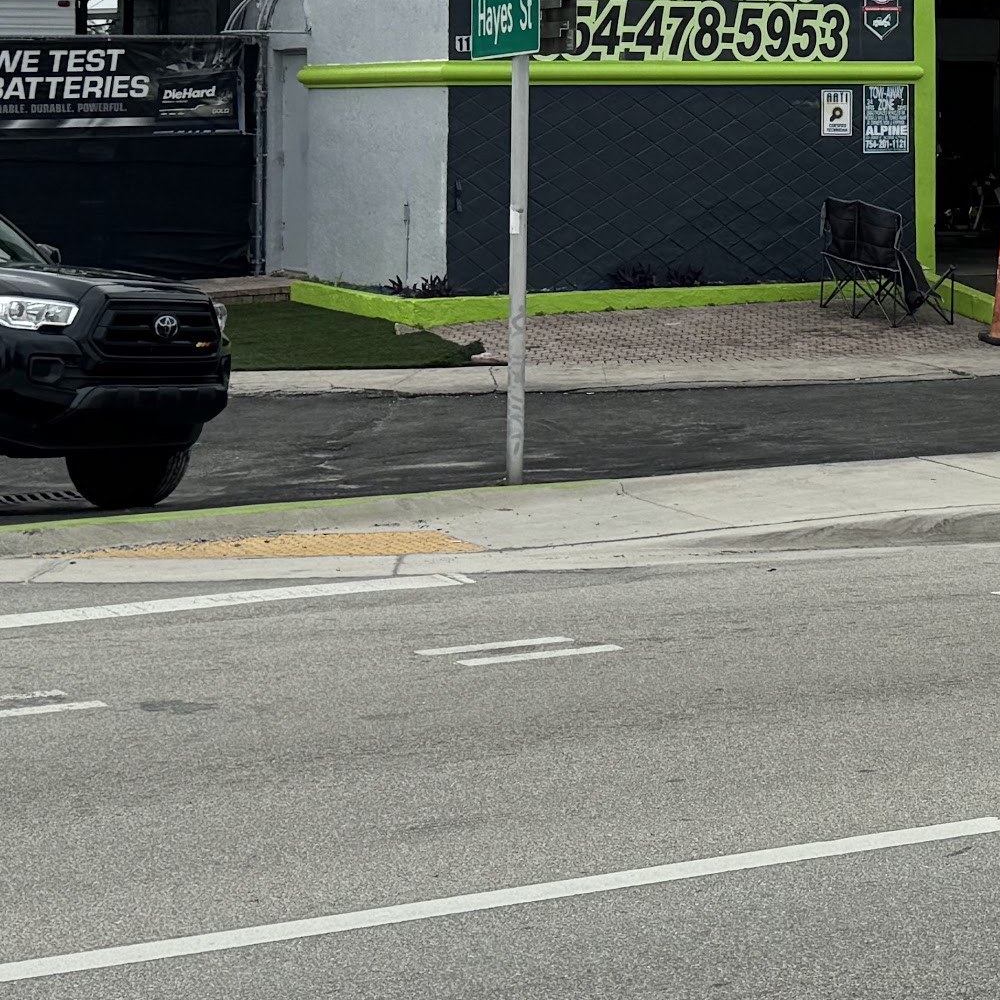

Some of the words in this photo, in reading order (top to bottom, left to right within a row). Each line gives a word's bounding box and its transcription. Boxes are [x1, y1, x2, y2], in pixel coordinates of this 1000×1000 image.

[477, 0, 513, 45] Hayes
[562, 0, 849, 61] 54-478-5953
[0, 49, 41, 73] WE
[49, 49, 125, 73] TEST
[162, 86, 216, 100] DieHard
[31, 103, 75, 114] DURABLE.
[77, 102, 127, 113] POWERFUL.
[866, 125, 907, 136] ALPINE
